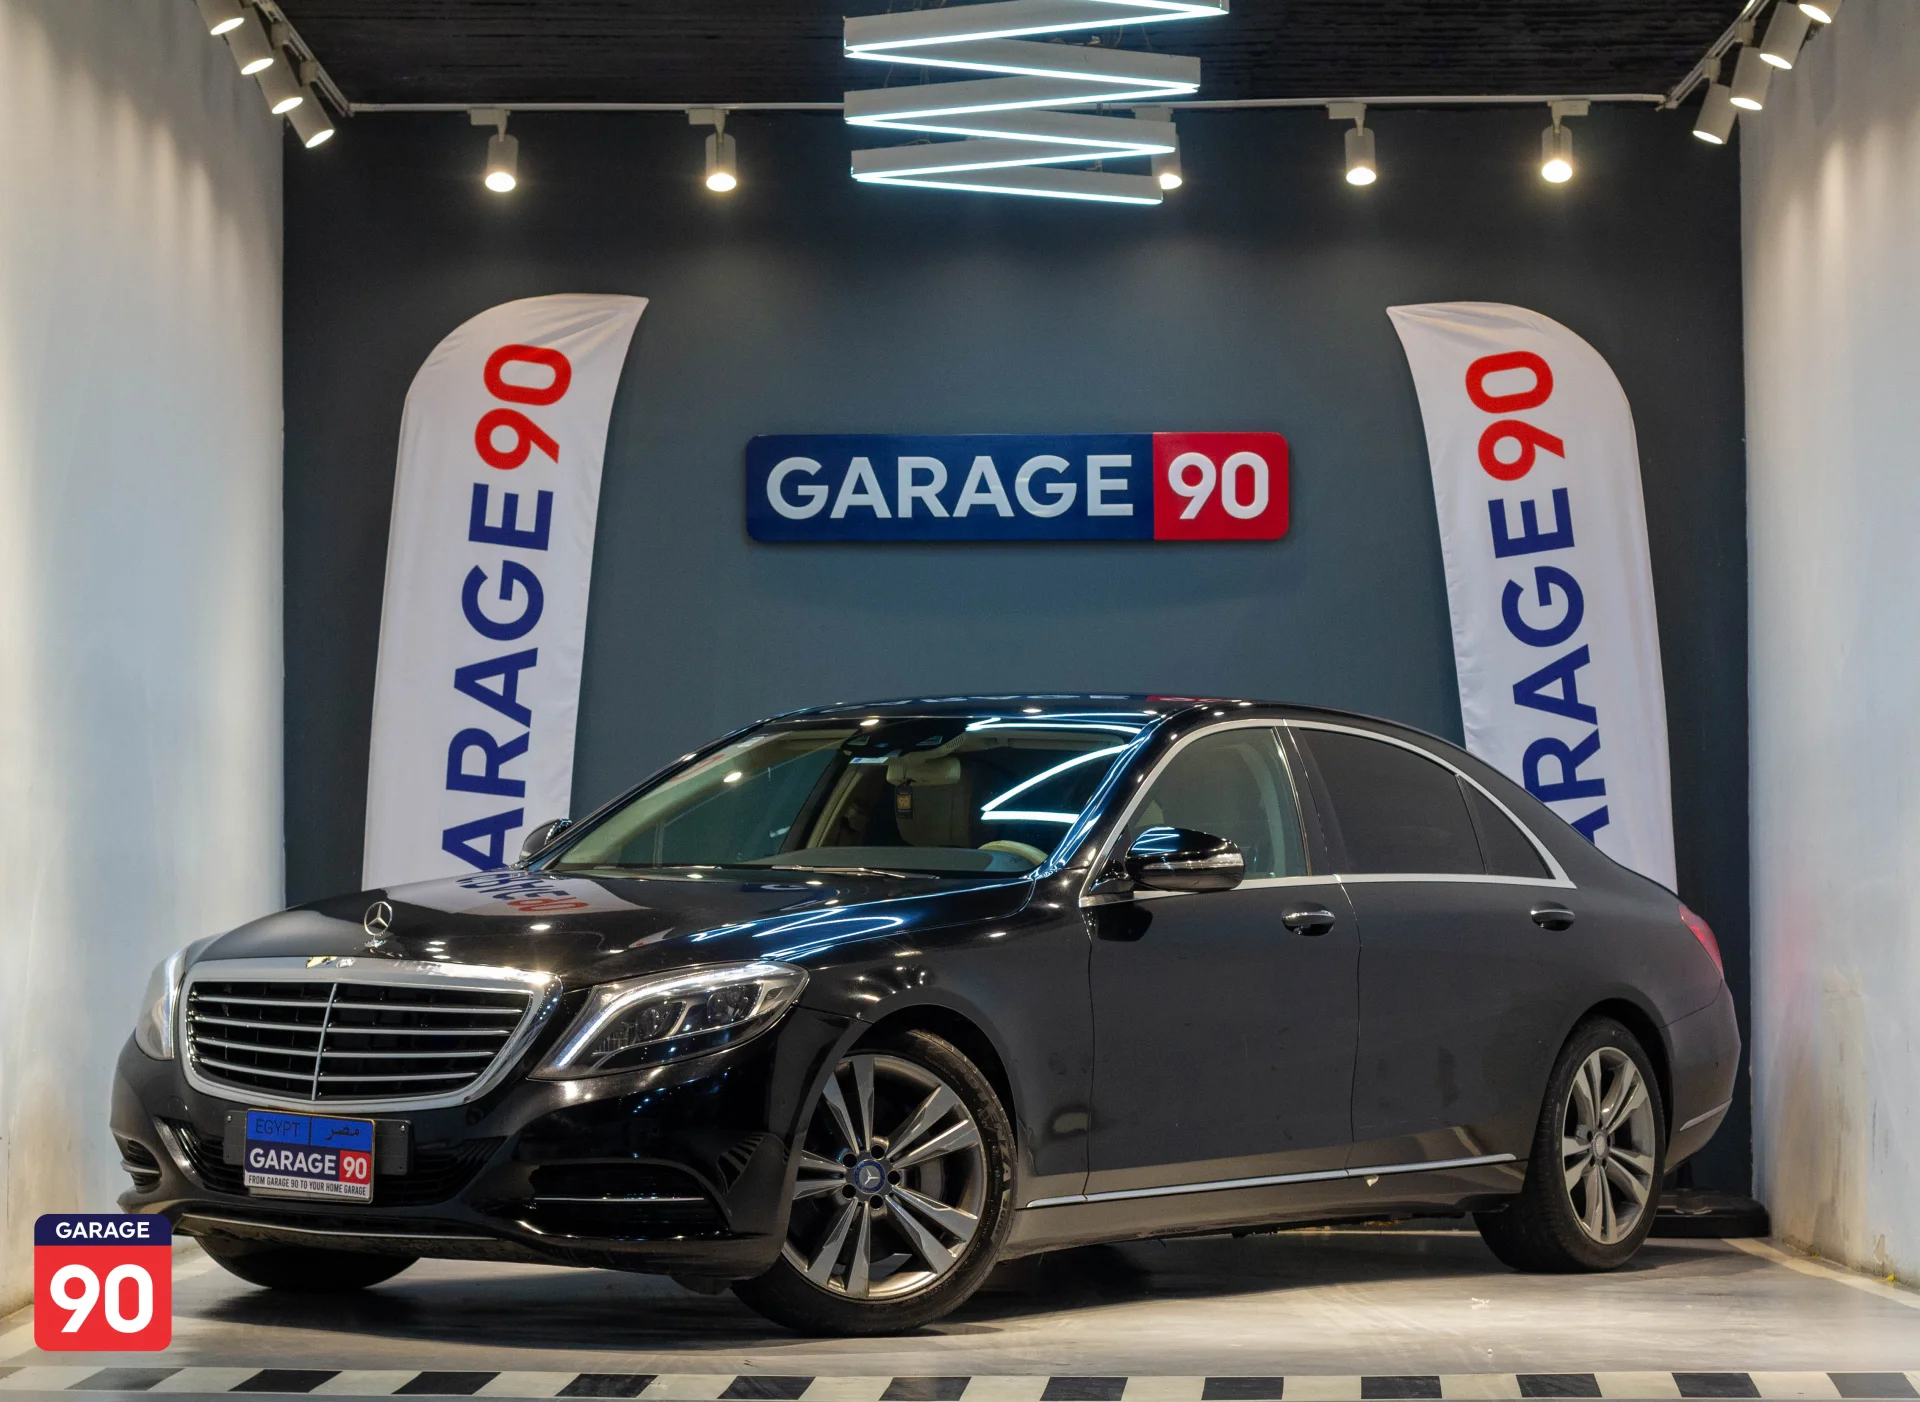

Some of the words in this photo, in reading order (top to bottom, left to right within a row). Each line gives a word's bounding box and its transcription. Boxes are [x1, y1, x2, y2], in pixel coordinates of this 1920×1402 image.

[474, 343, 572, 471] 90
[1465, 350, 1566, 482] 90
[766, 454, 1133, 520] GARAGE
[1167, 451, 1270, 520] 90
[255, 1118, 300, 1138] EGYPT
[325, 1126, 360, 1141] مصر
[249, 1147, 337, 1175] GARAGE
[343, 1156, 367, 1180] 90
[248, 1175, 265, 1185] FROM
[266, 1177, 290, 1188] GARAGE
[290, 1179, 299, 1189] 90
[300, 1180, 308, 1190] TO
[309, 1181, 325, 1192] YOUR
[325, 1183, 342, 1194] HOME
[343, 1185, 366, 1196] GARAGE
